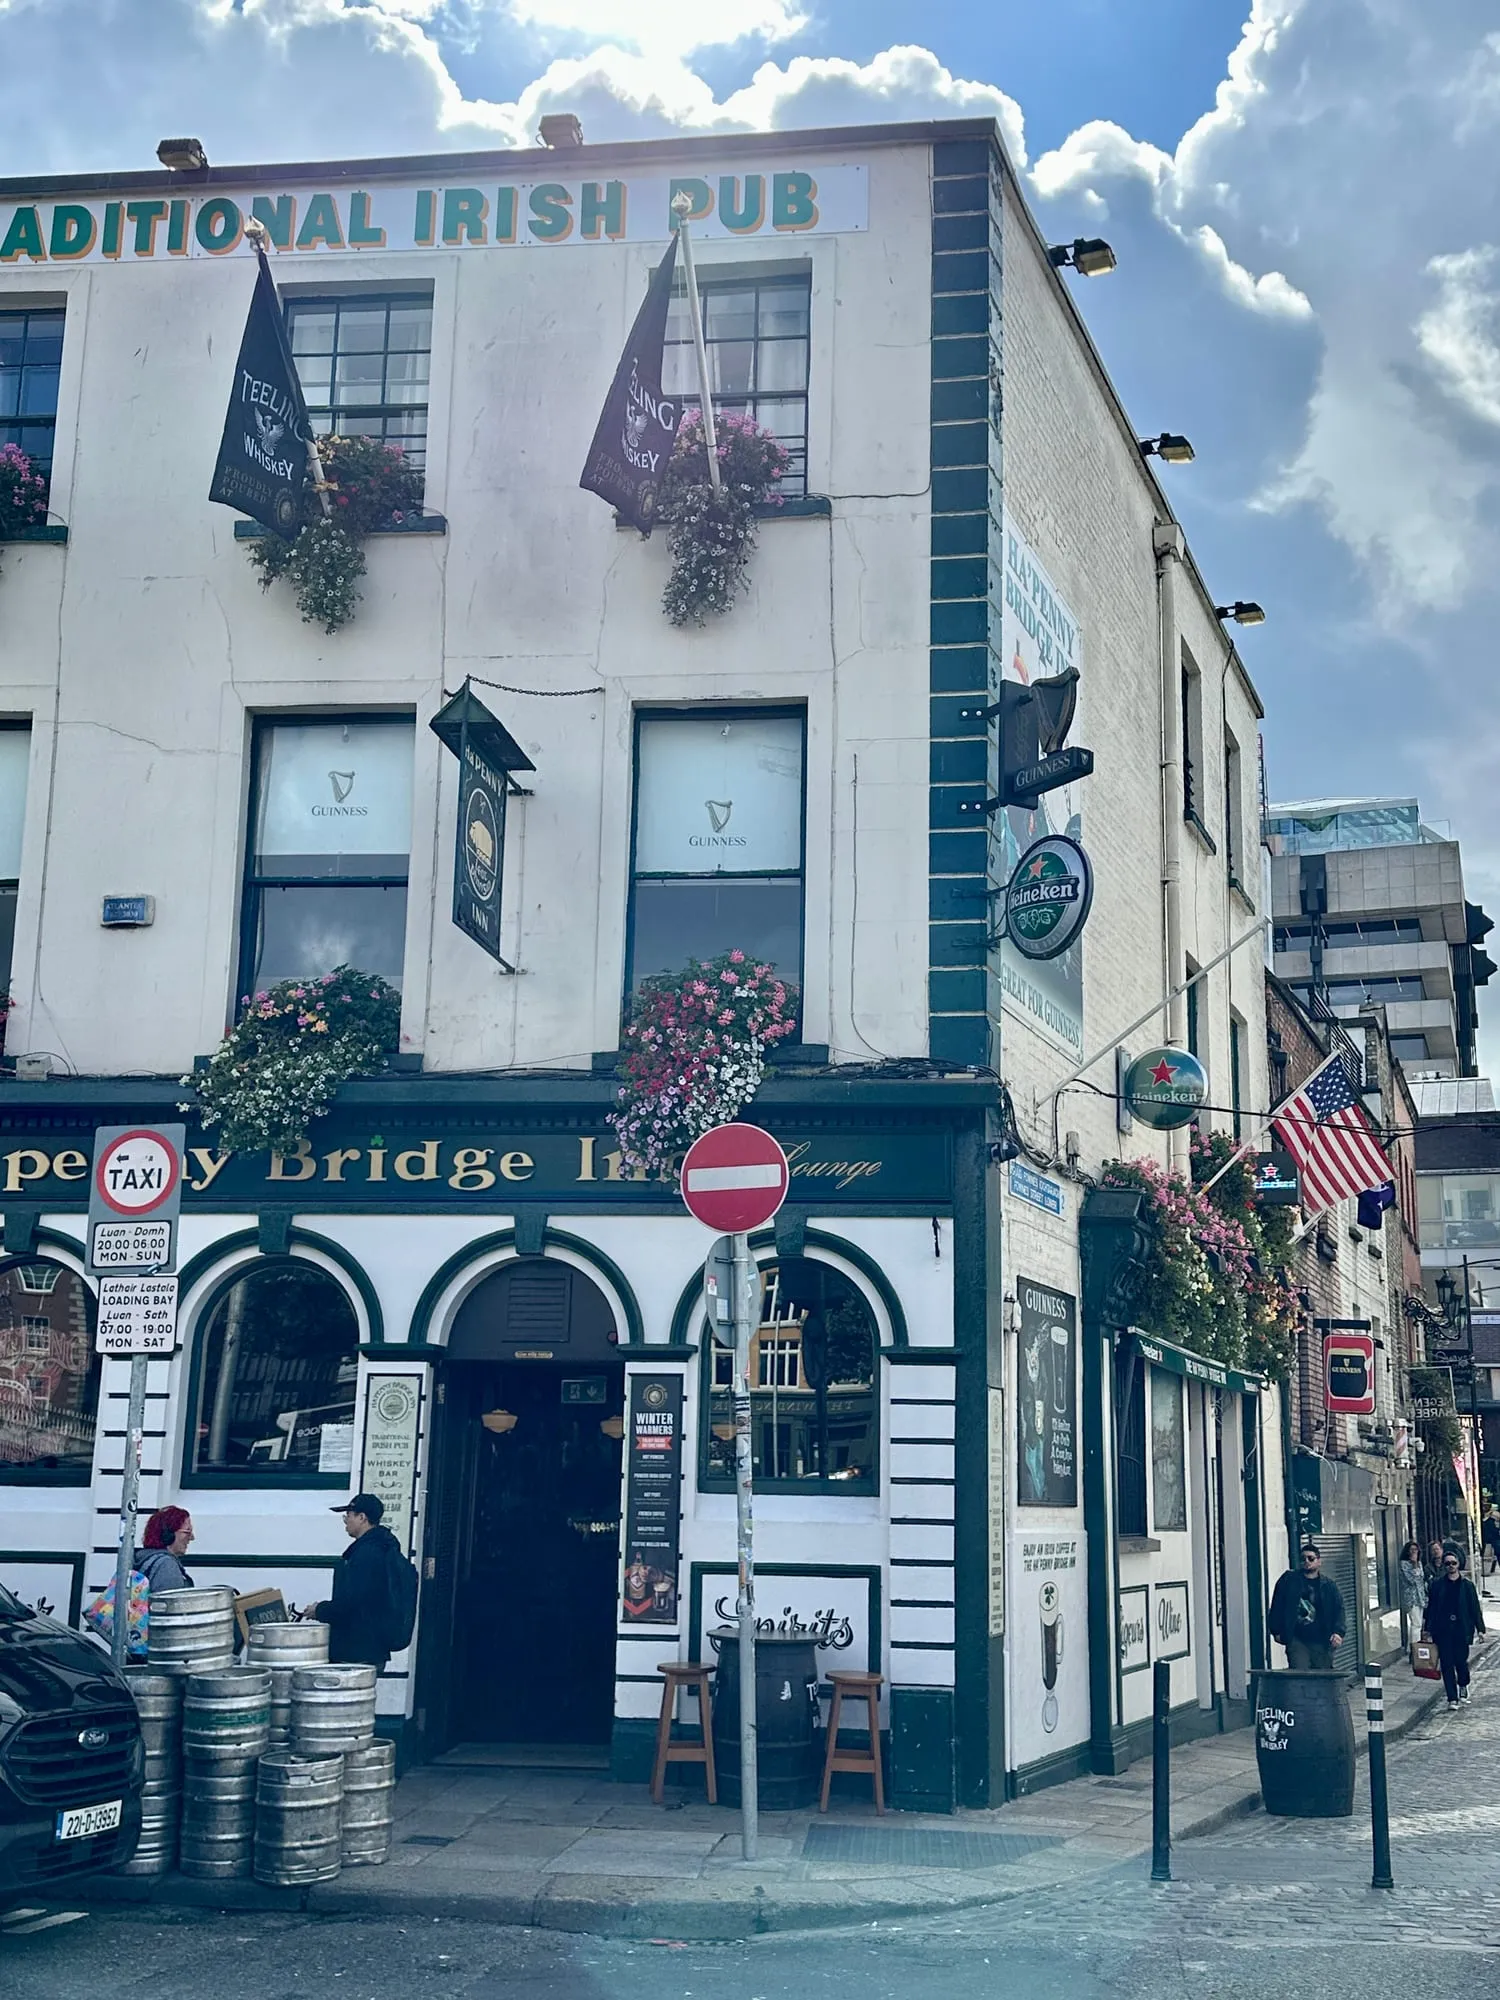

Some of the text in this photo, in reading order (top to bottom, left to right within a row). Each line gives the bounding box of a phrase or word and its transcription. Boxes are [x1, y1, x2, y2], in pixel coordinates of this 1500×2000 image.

[414, 180, 628, 247] IRISH
[668, 171, 819, 235] PUB
[243, 431, 294, 481] WHISKEY
[621, 430, 660, 473] ISKEY
[1008, 530, 1074, 659] HA'PENNY
[1006, 571, 1053, 667] BRIDGE
[1016, 753, 1070, 788] GUINNESS
[311, 805, 368, 817] GUINNESS
[689, 835, 747, 847] GUINNESS
[472, 902, 488, 933] INN
[1132, 1091, 1197, 1104] Heineken
[266, 1138, 535, 1191] Bridge
[576, 1136, 683, 1182] In
[109, 1167, 163, 1190] TAXI
[1254, 1179, 1297, 1190] eineken
[101, 1227, 126, 1237] Luan
[134, 1227, 165, 1236] Domh
[100, 1252, 127, 1261] MON
[136, 1251, 162, 1260] SUN
[103, 1282, 175, 1293] Lathair Lastala
[103, 1296, 174, 1305] LOADING BAY
[1025, 1288, 1067, 1320] GUINNESS
[107, 1311, 132, 1319] Luan
[144, 1310, 168, 1319] Sath
[105, 1338, 132, 1348] MON
[144, 1338, 165, 1347] SAT
[1331, 1366, 1362, 1374] GUINNESS
[636, 1413, 674, 1425] WINTER
[635, 1425, 674, 1435] WARMERS
[367, 1460, 411, 1468] WHISKEY
[378, 1470, 398, 1478] BAR
